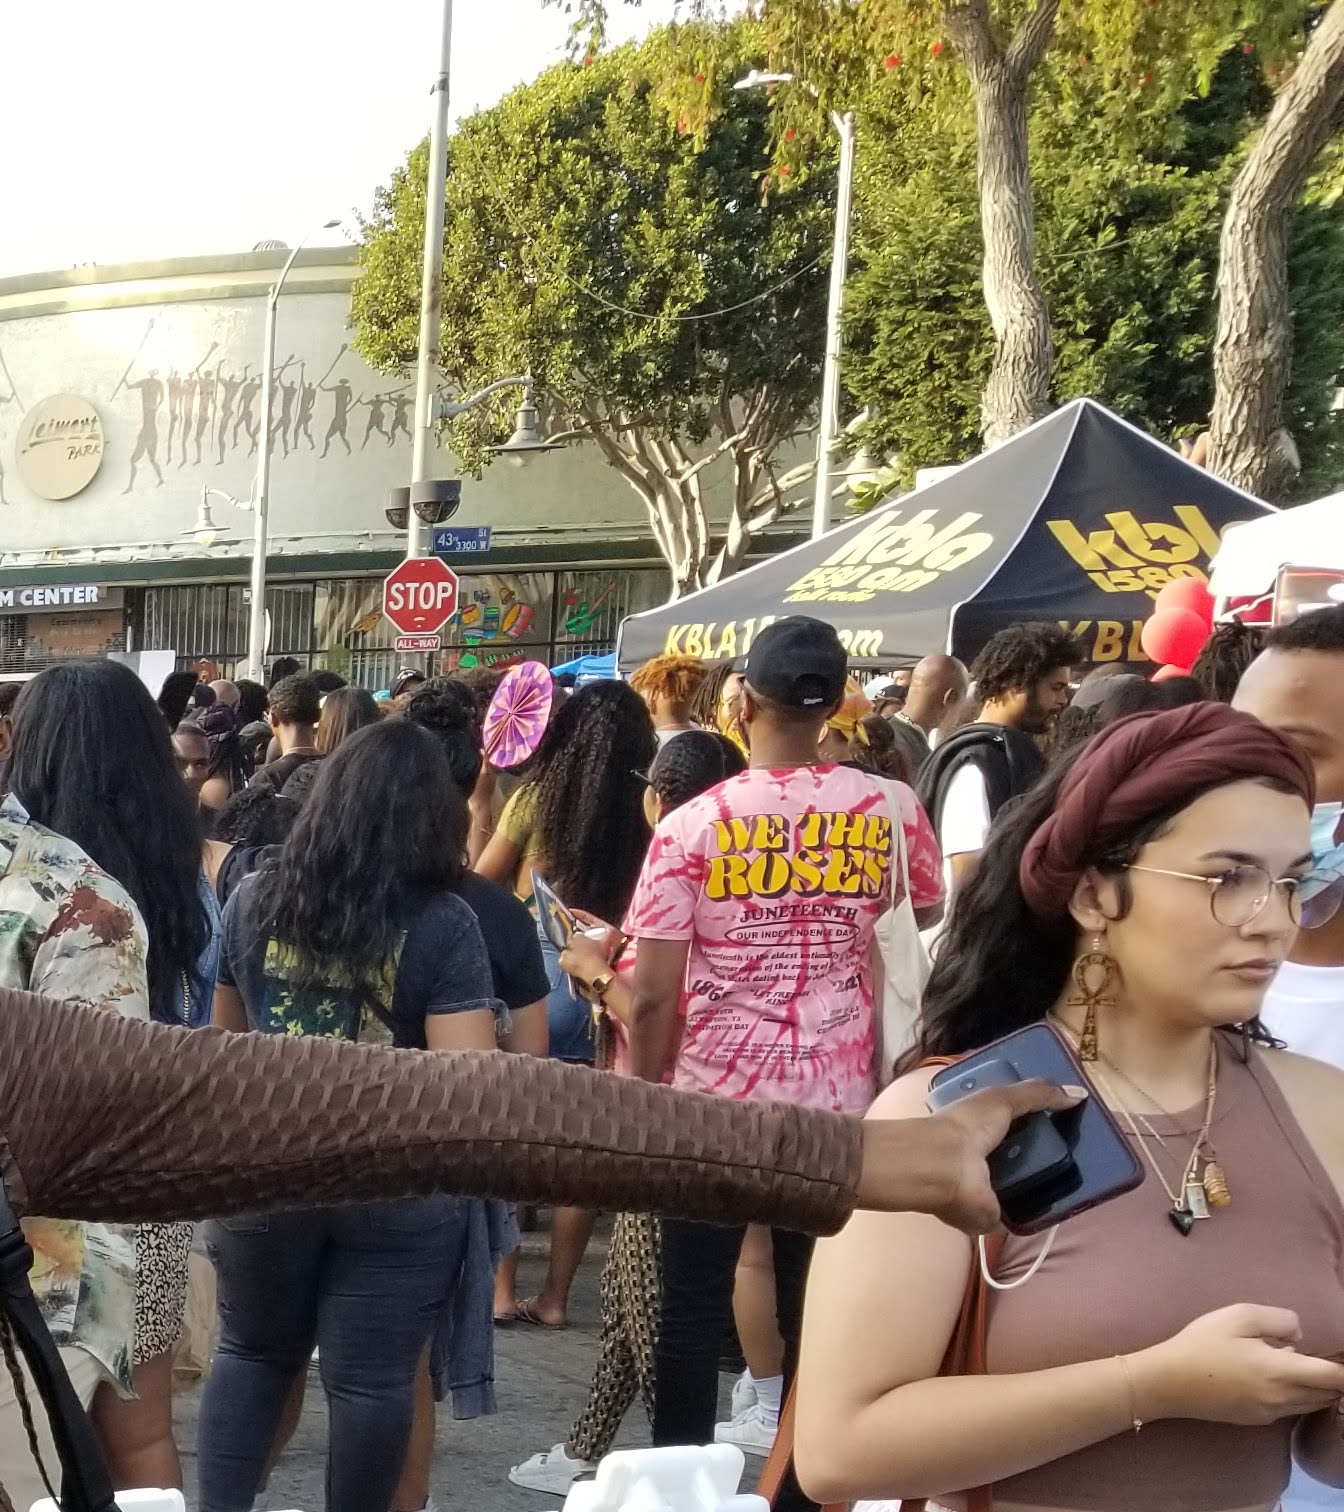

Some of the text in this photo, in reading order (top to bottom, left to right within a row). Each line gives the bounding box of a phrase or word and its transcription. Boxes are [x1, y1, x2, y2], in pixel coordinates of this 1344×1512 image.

[67, 444, 100, 459] PARK
[1046, 505, 1222, 571] kbl
[20, 585, 99, 607] CENTER
[388, 581, 453, 610] STOP
[397, 637, 438, 649] ALL-WAY
[709, 812, 891, 855] WE THE
[705, 850, 889, 901] ROSES
[740, 904, 858, 924] JUNETEENTH
[736, 931, 759, 940] OUR
